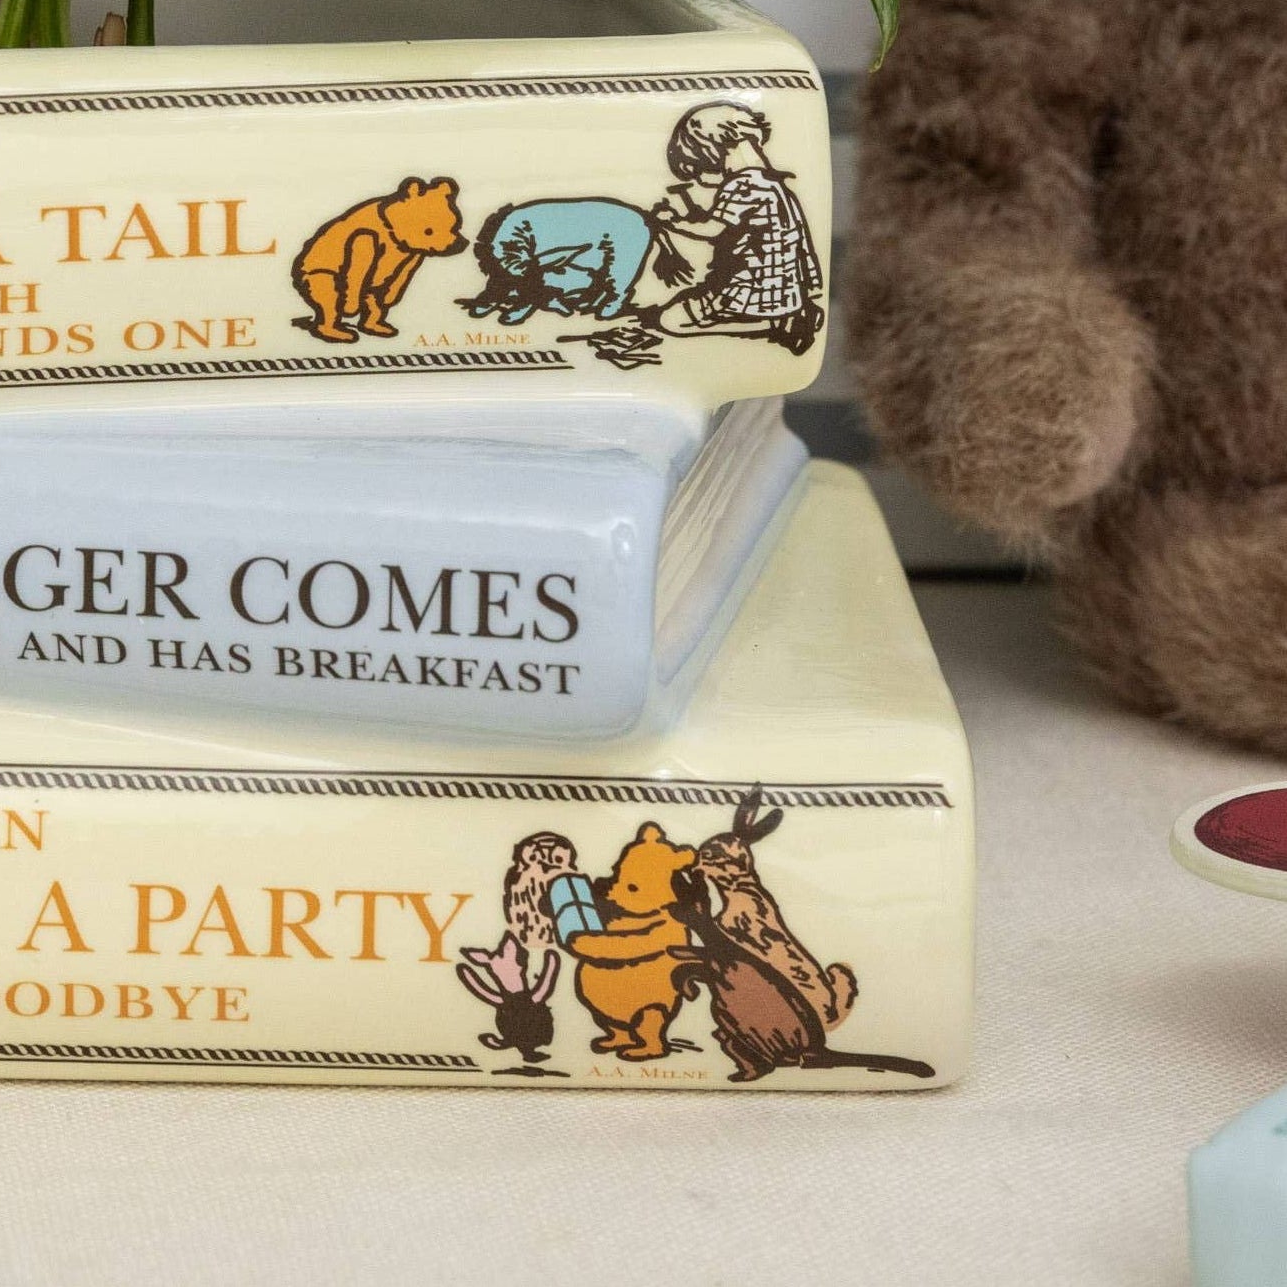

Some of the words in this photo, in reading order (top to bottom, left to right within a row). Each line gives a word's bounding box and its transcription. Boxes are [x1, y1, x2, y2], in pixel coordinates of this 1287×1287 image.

[39, 199, 277, 264] TAIL
[123, 318, 258, 351] ONE
[413, 333, 456, 347] A.A.
[229, 556, 580, 644] COMES
[17, 631, 128, 665] AND
[147, 638, 253, 674] HAS
[274, 646, 581, 695] BREAKFAST
[17, 879, 95, 953] A
[126, 882, 475, 963] PARTY
